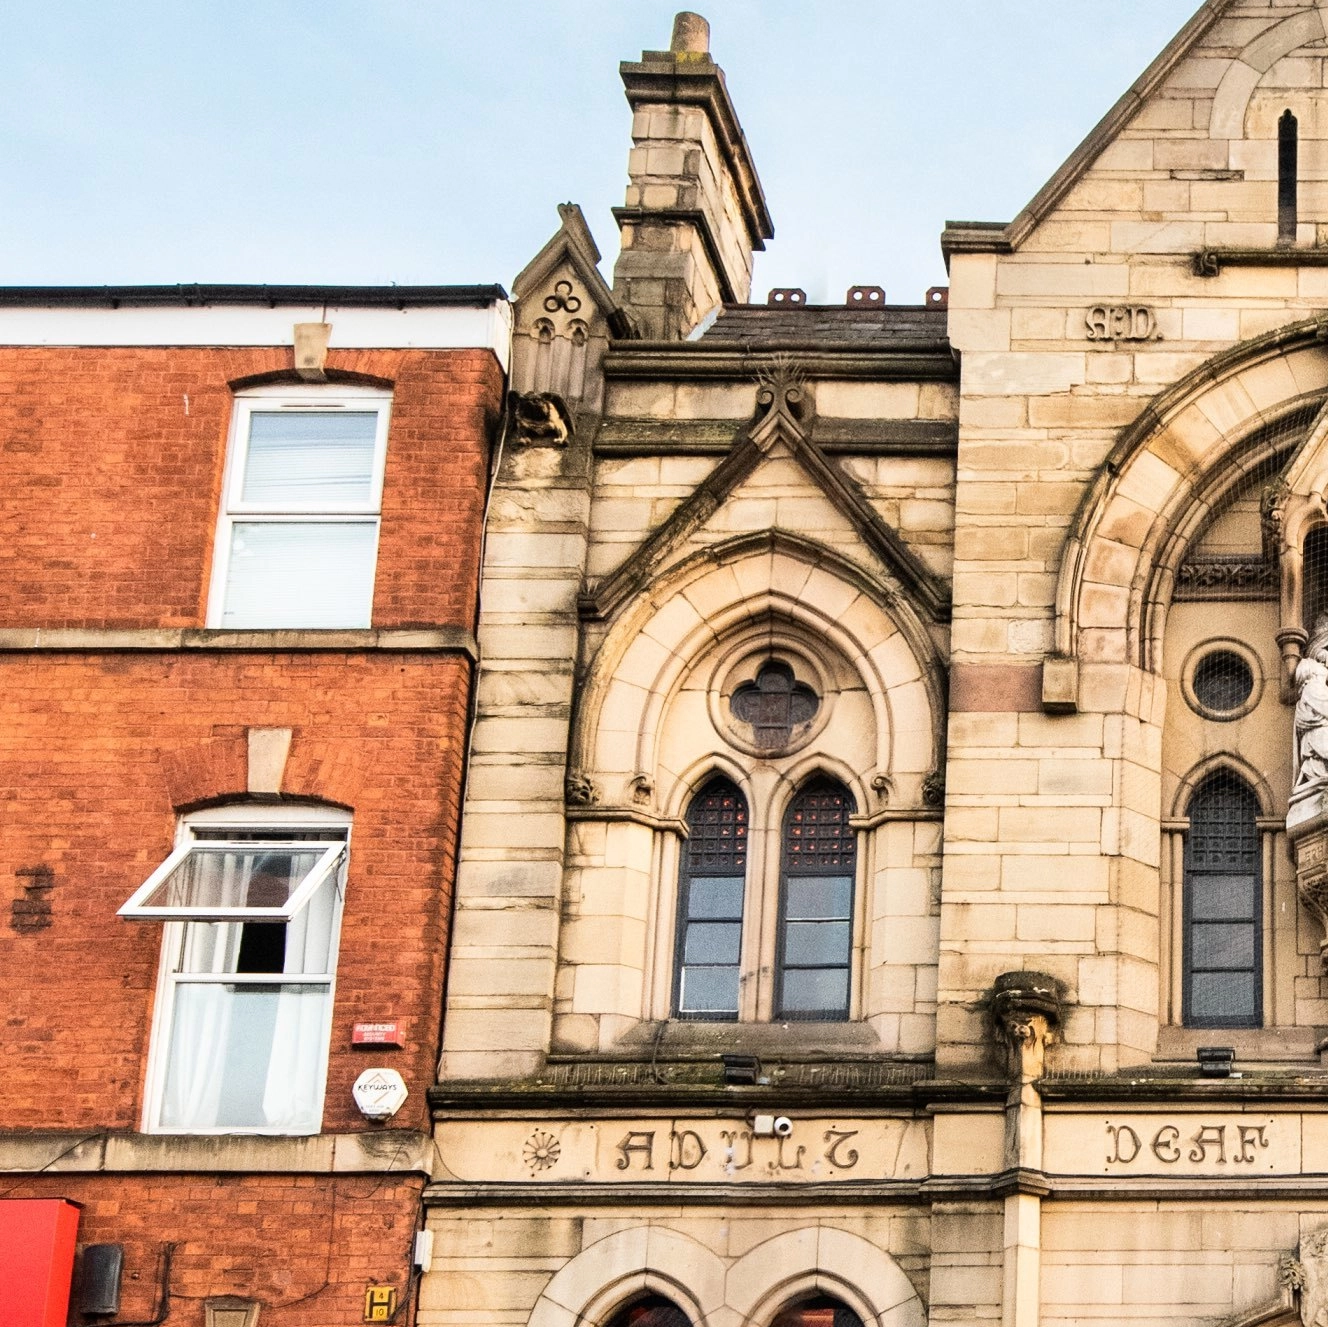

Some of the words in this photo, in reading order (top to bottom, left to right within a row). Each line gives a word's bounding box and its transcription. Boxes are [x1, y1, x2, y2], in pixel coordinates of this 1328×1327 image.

[616, 1129, 859, 1170] ADULT
[1105, 1125, 1268, 1164] DEAF
[369, 1290, 393, 1318] H
